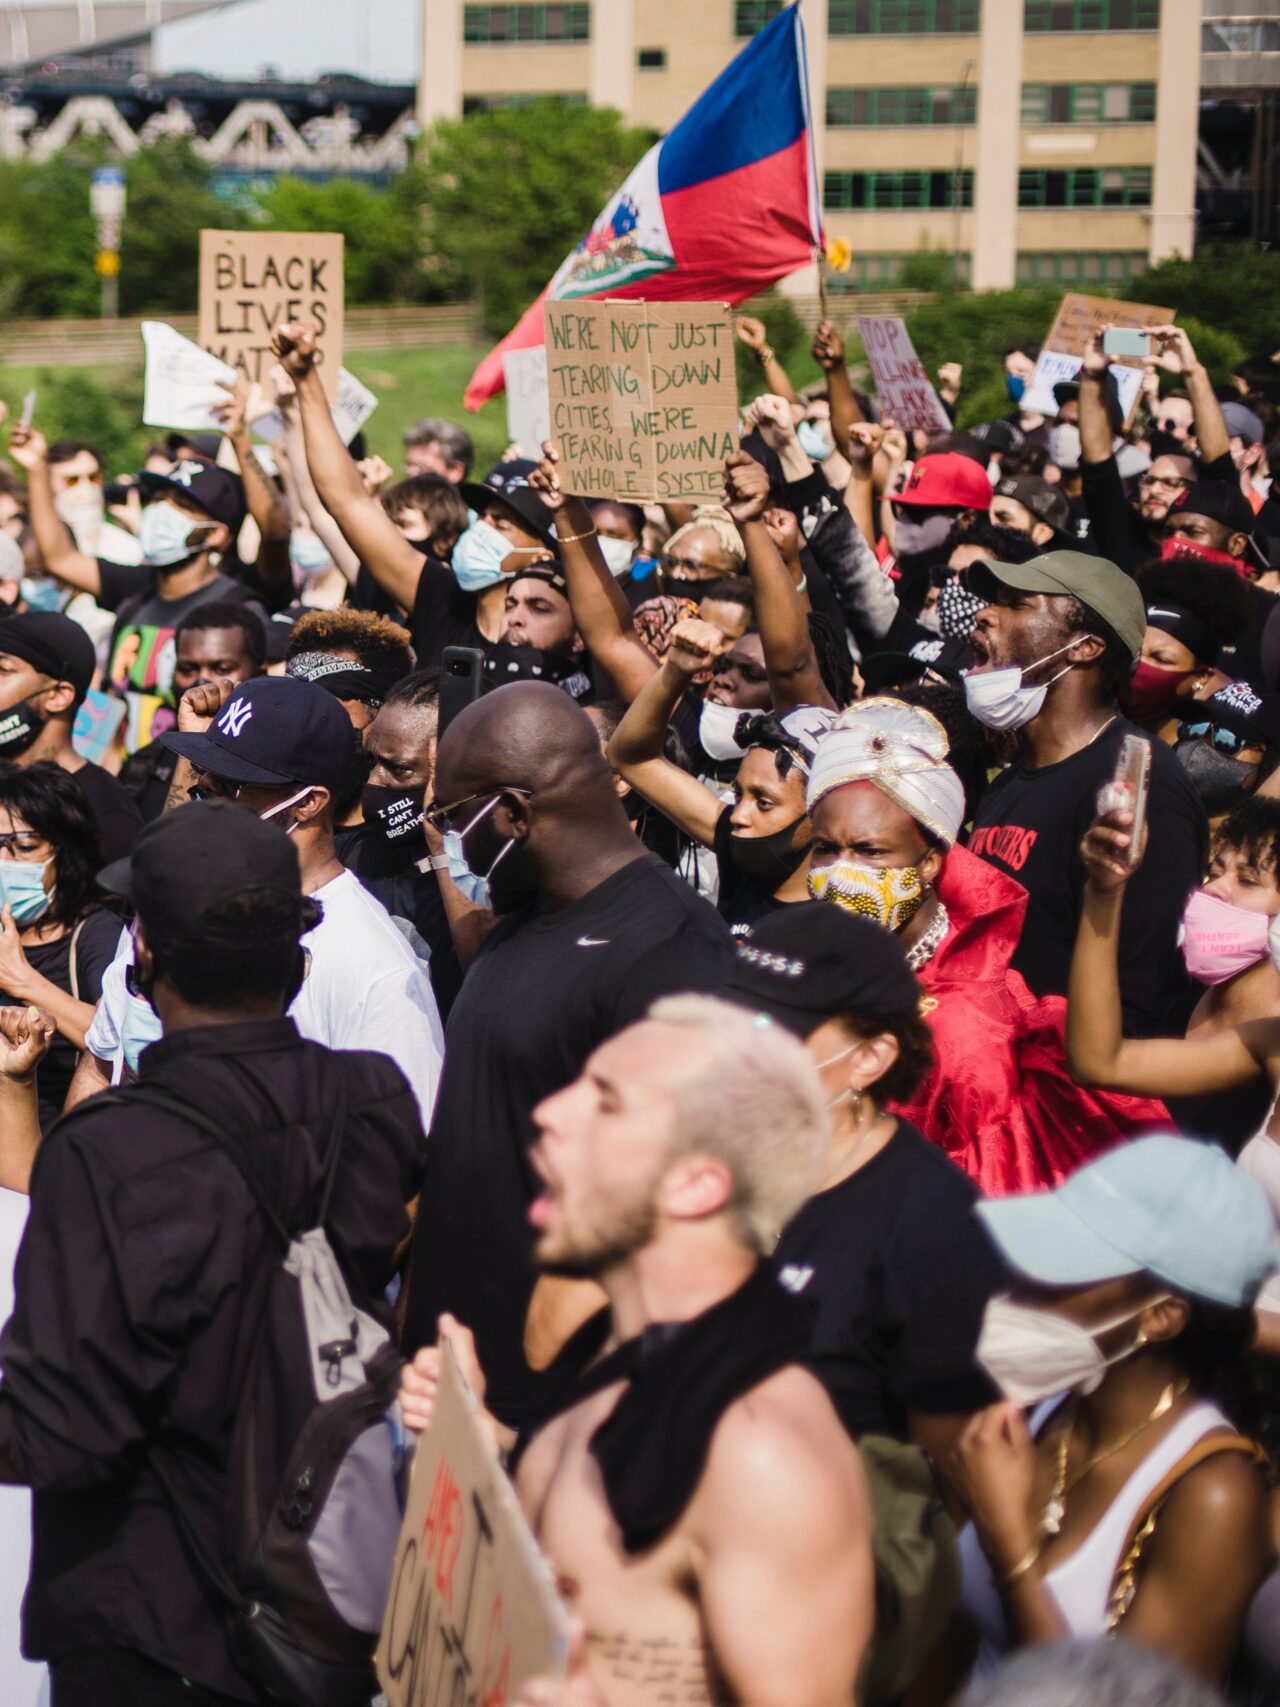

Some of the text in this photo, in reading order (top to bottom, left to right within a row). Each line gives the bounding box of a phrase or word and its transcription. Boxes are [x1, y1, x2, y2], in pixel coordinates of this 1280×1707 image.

[215, 253, 328, 292] BLACK
[215, 300, 327, 337] LIVES
[611, 319, 659, 353] NOT
[669, 322, 726, 350] JUST
[552, 364, 640, 399] TEARING
[653, 358, 721, 393] DOWN
[557, 433, 642, 469] TEARING
[656, 431, 717, 464] DOWN
[572, 467, 726, 495] WHOLE SYSTE
[378, 797, 414, 818] I STILL
